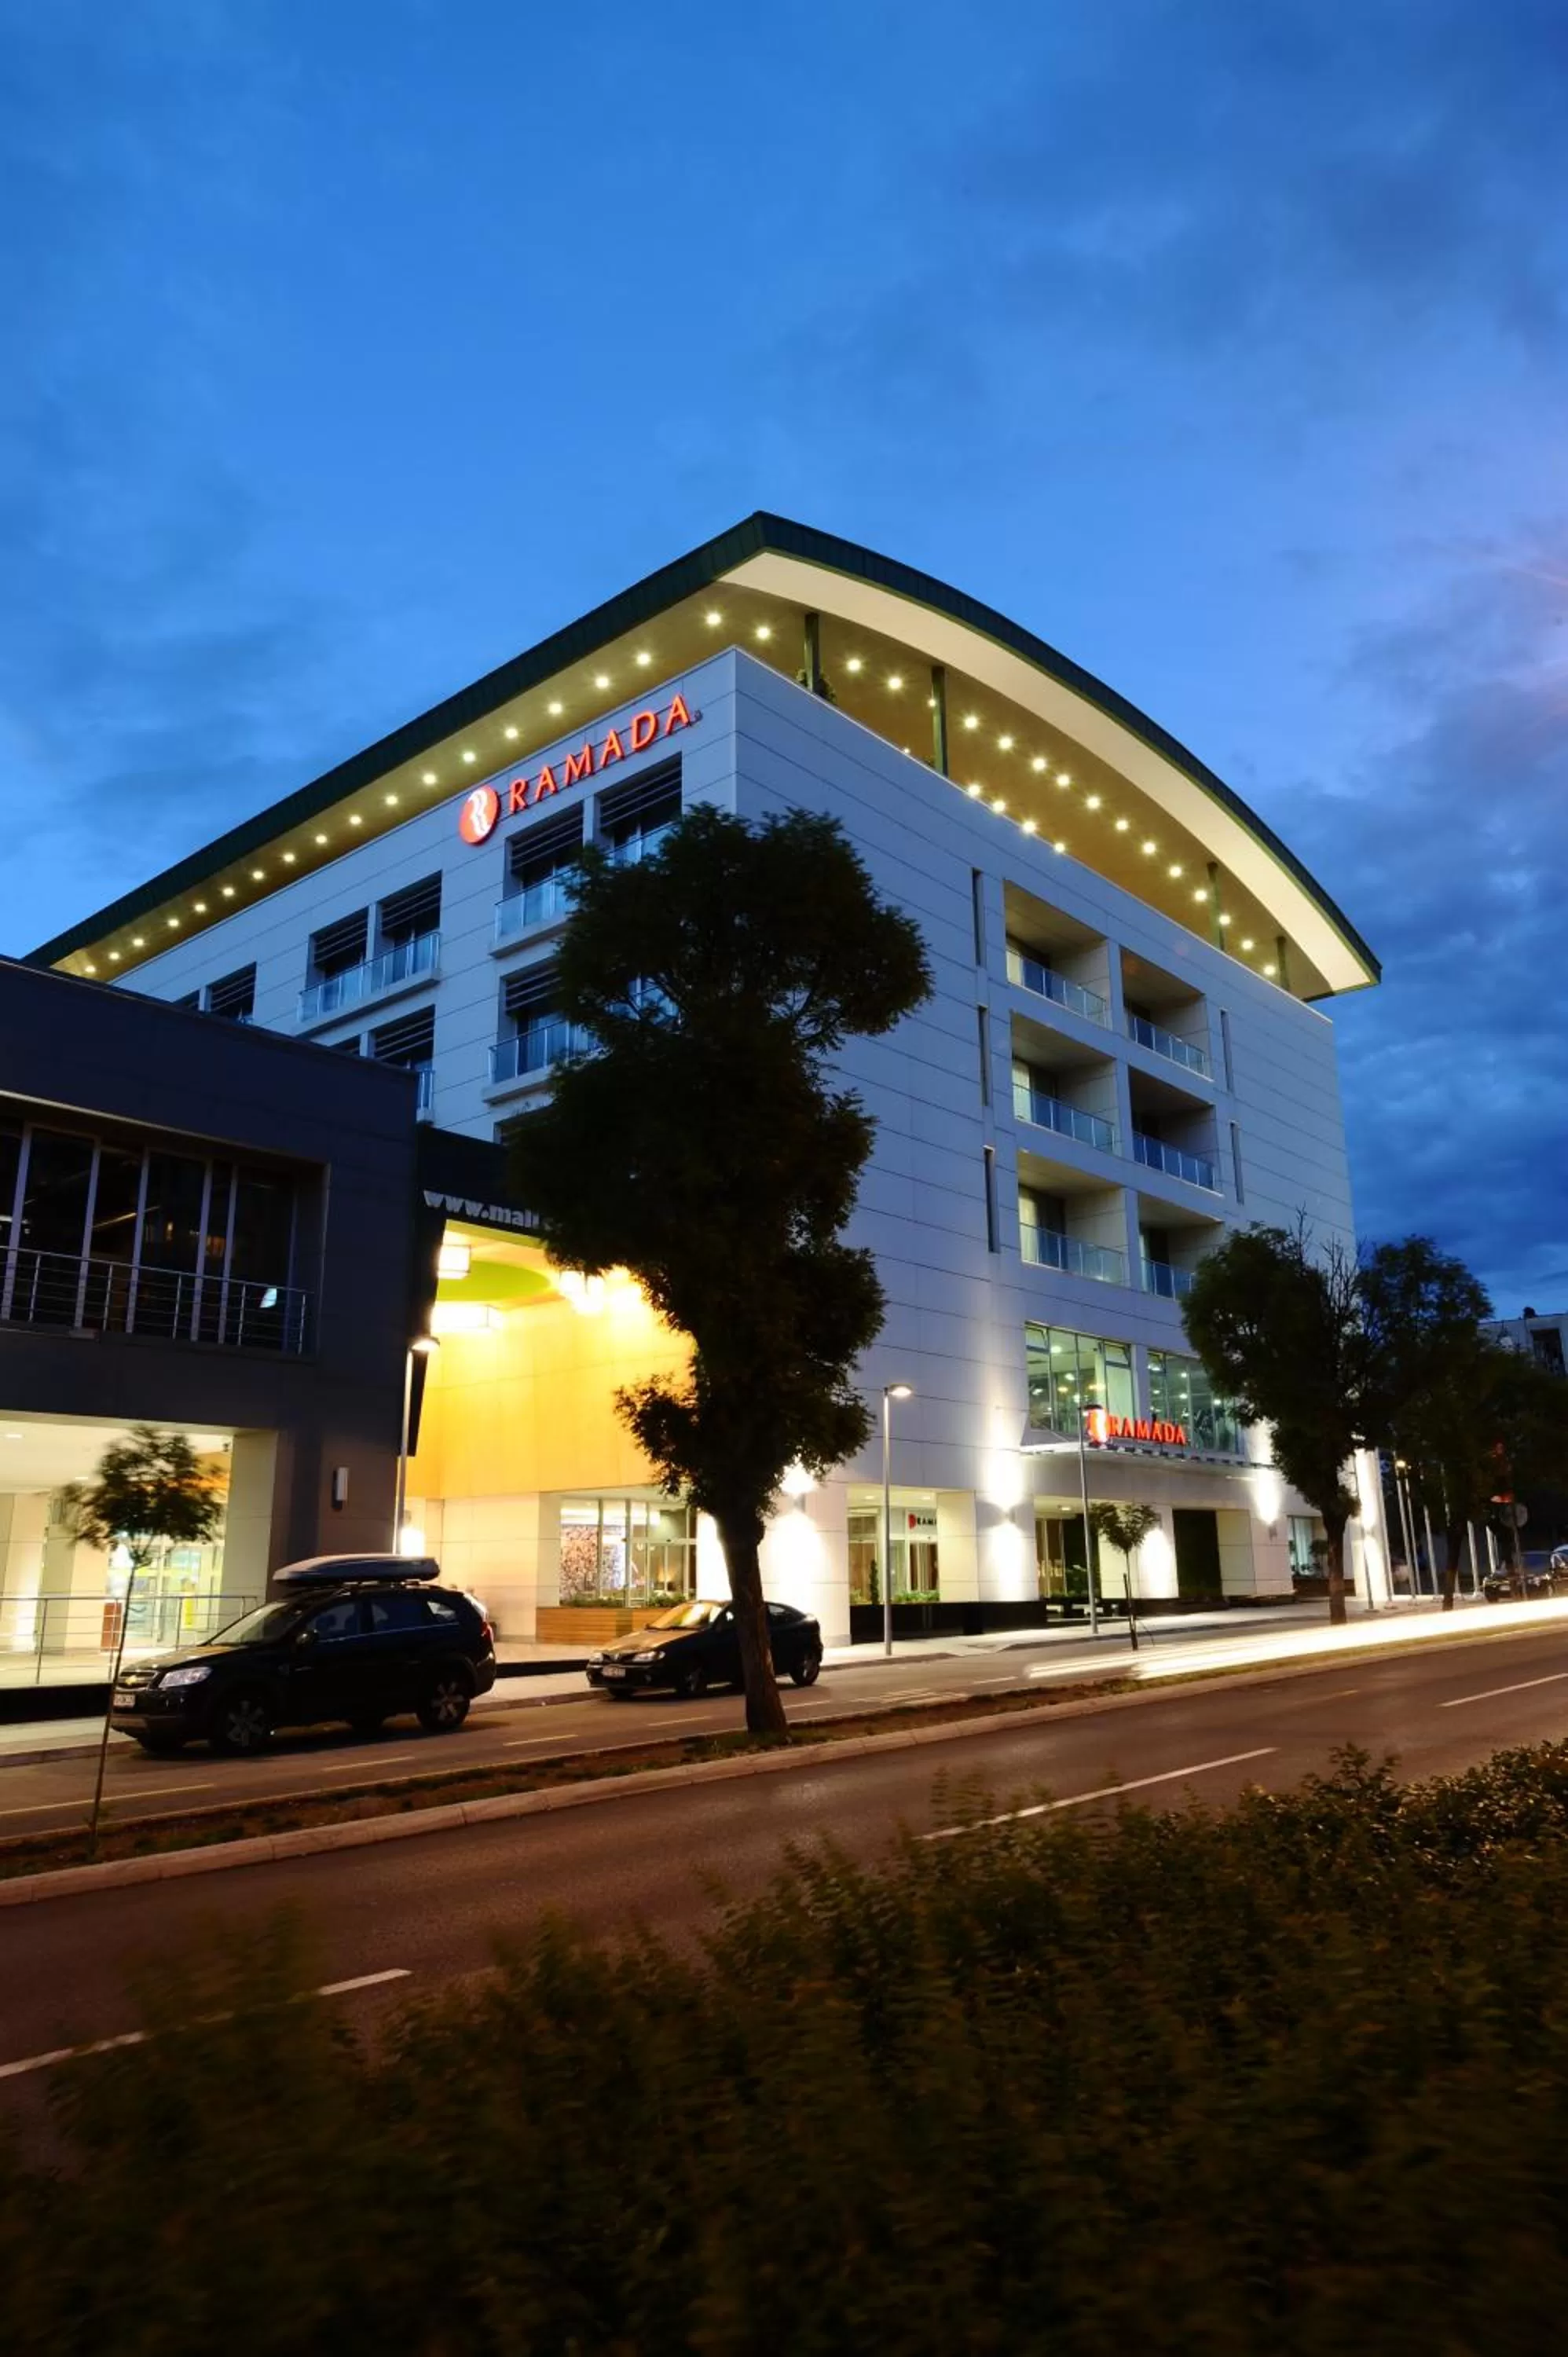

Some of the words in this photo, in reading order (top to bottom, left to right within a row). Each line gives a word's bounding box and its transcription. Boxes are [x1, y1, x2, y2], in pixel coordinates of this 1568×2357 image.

[510, 694, 691, 814] RAMADA
[423, 1190, 546, 1230] www.mall
[1108, 1415, 1187, 1445] RAMADA
